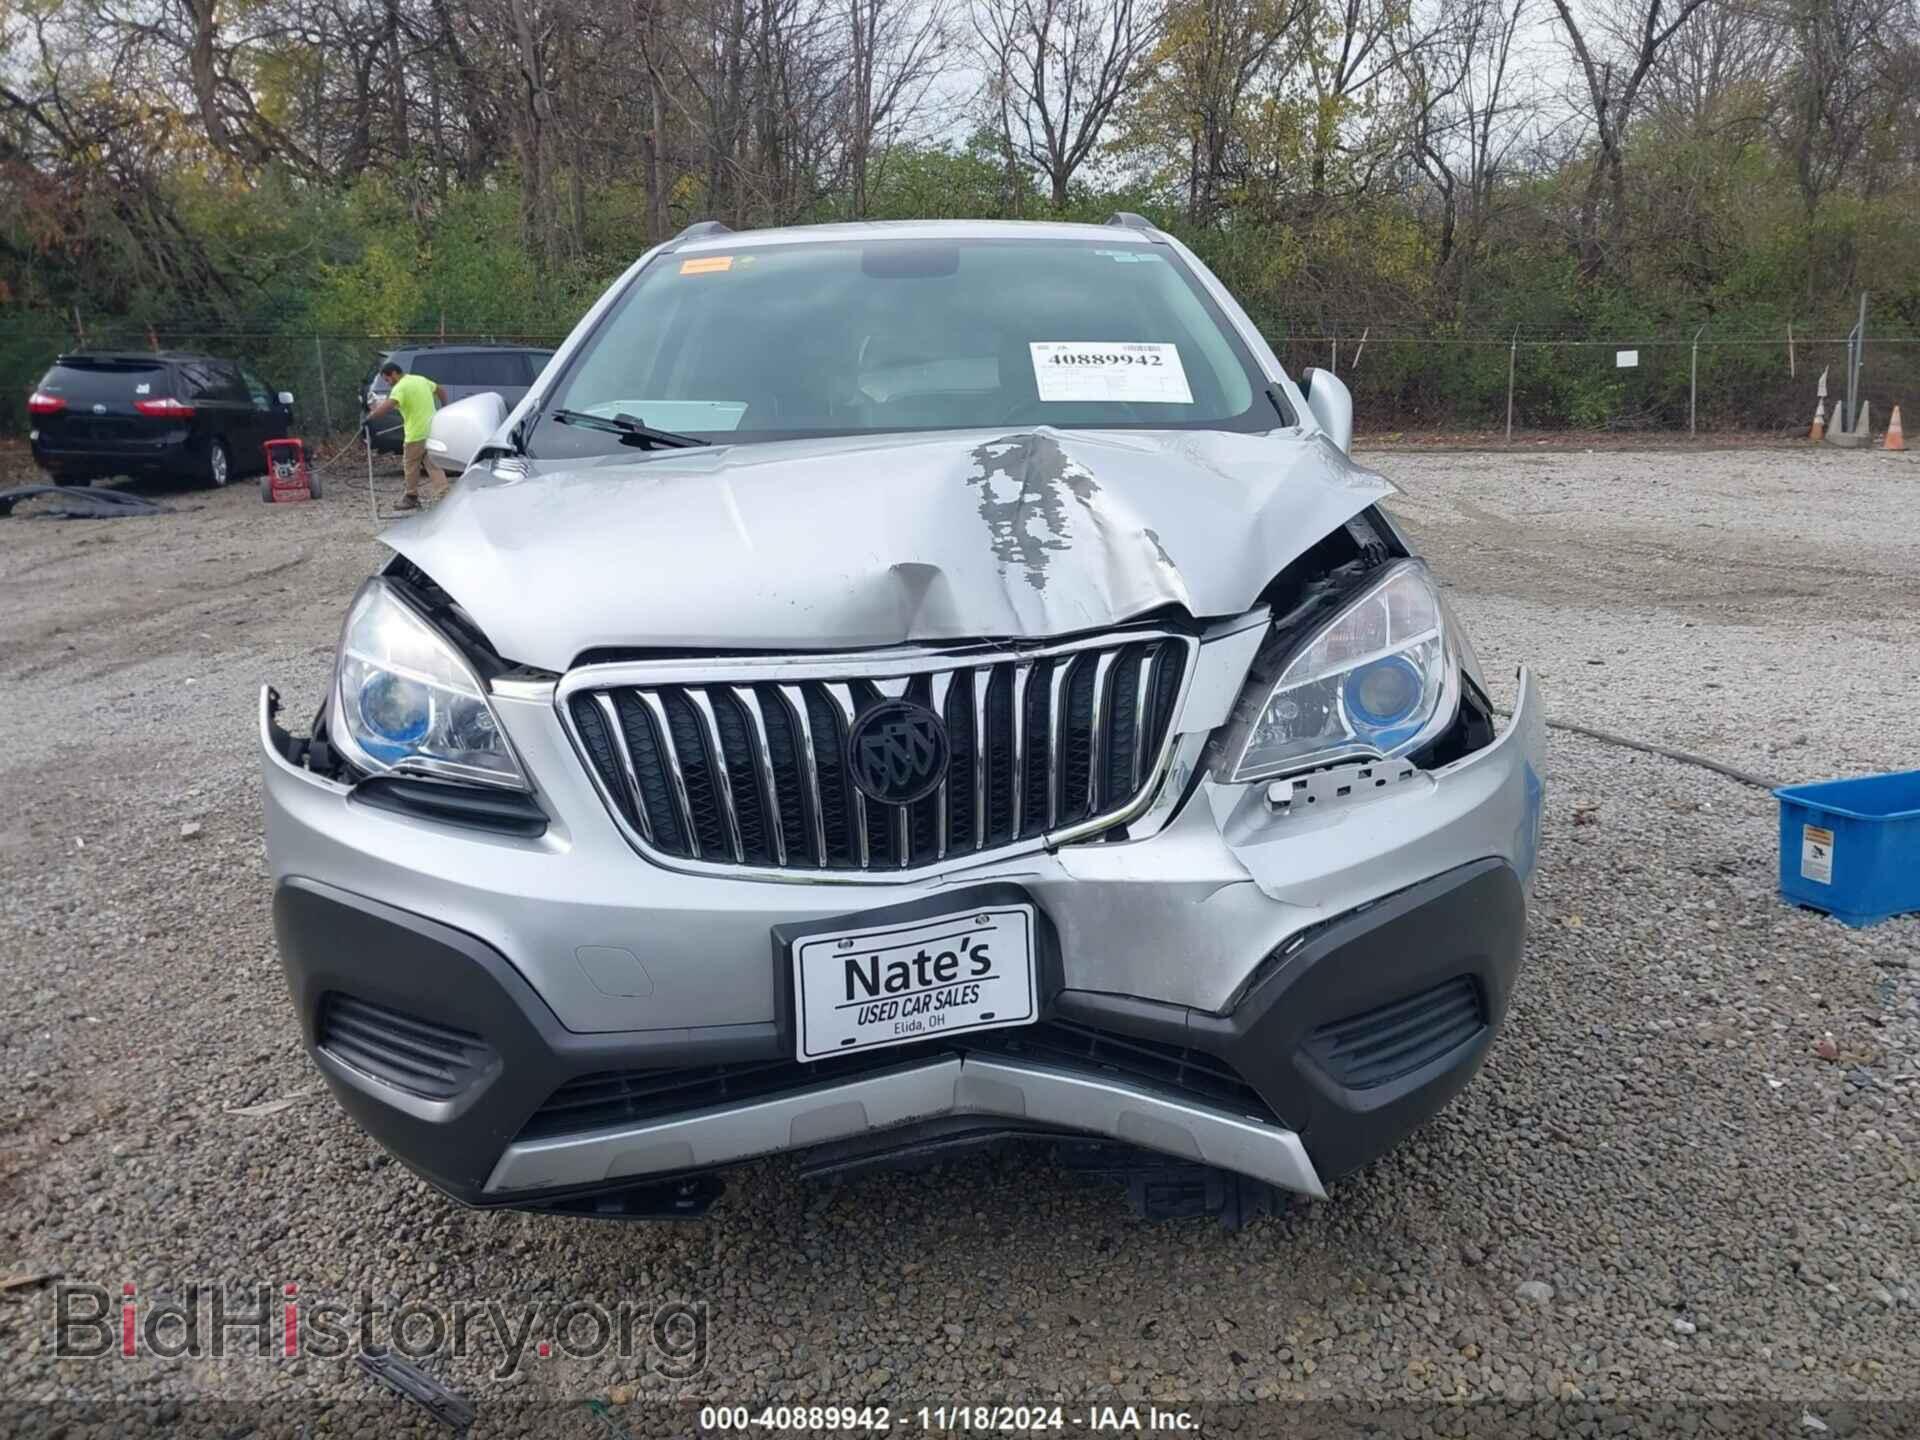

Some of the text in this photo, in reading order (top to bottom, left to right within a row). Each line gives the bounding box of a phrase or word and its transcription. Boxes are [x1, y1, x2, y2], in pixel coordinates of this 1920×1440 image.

[1048, 353, 1163, 366] 40889942
[845, 937, 992, 1001] Nate's
[858, 984, 980, 1025] USED CAR SALES
[894, 1014, 945, 1034] Elida, OH
